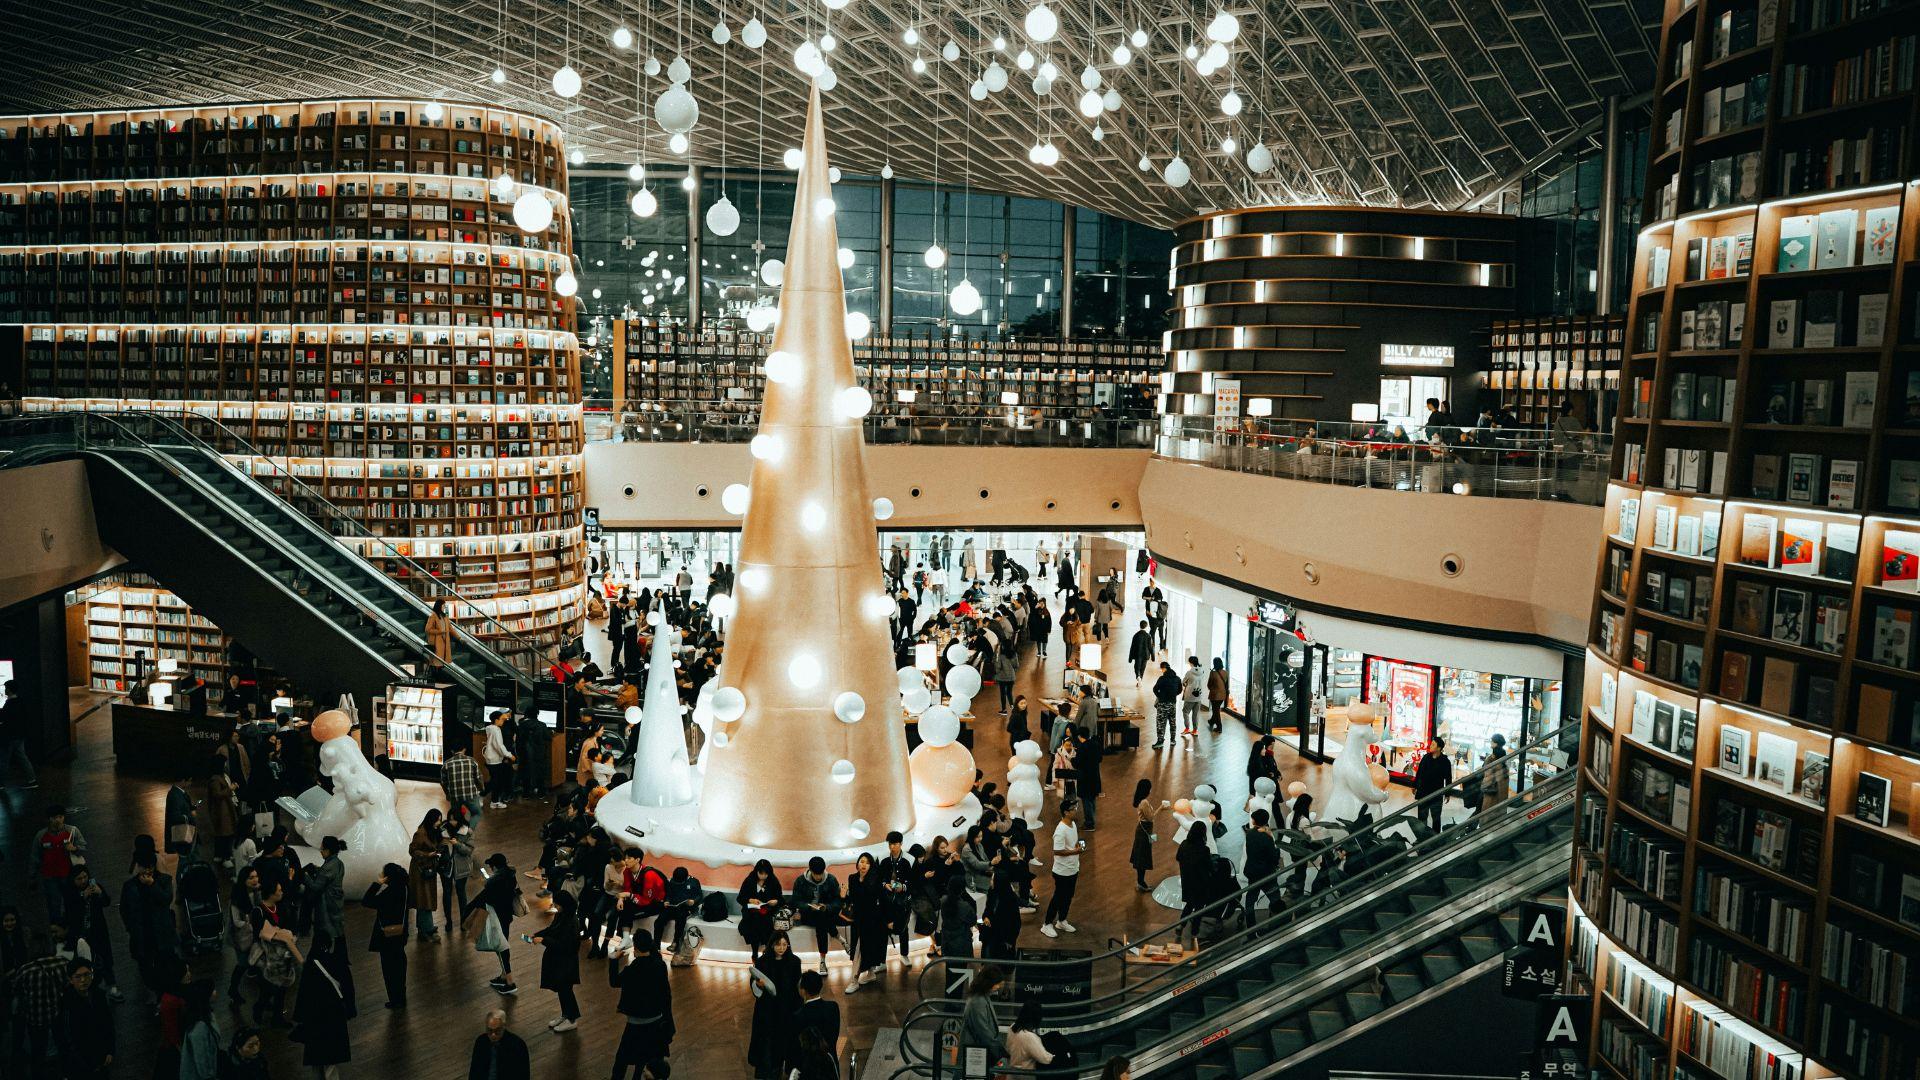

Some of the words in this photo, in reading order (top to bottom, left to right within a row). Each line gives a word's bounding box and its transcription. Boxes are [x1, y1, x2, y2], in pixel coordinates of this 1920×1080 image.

[1384, 344, 1414, 357] BILLY
[1419, 346, 1454, 358] ANGEL
[1526, 913, 1555, 946] A
[1505, 959, 1515, 987] Fiction
[1520, 965, 1556, 986] 소설
[1545, 1006, 1578, 1042] A
[1543, 1062, 1577, 1078] 무역
